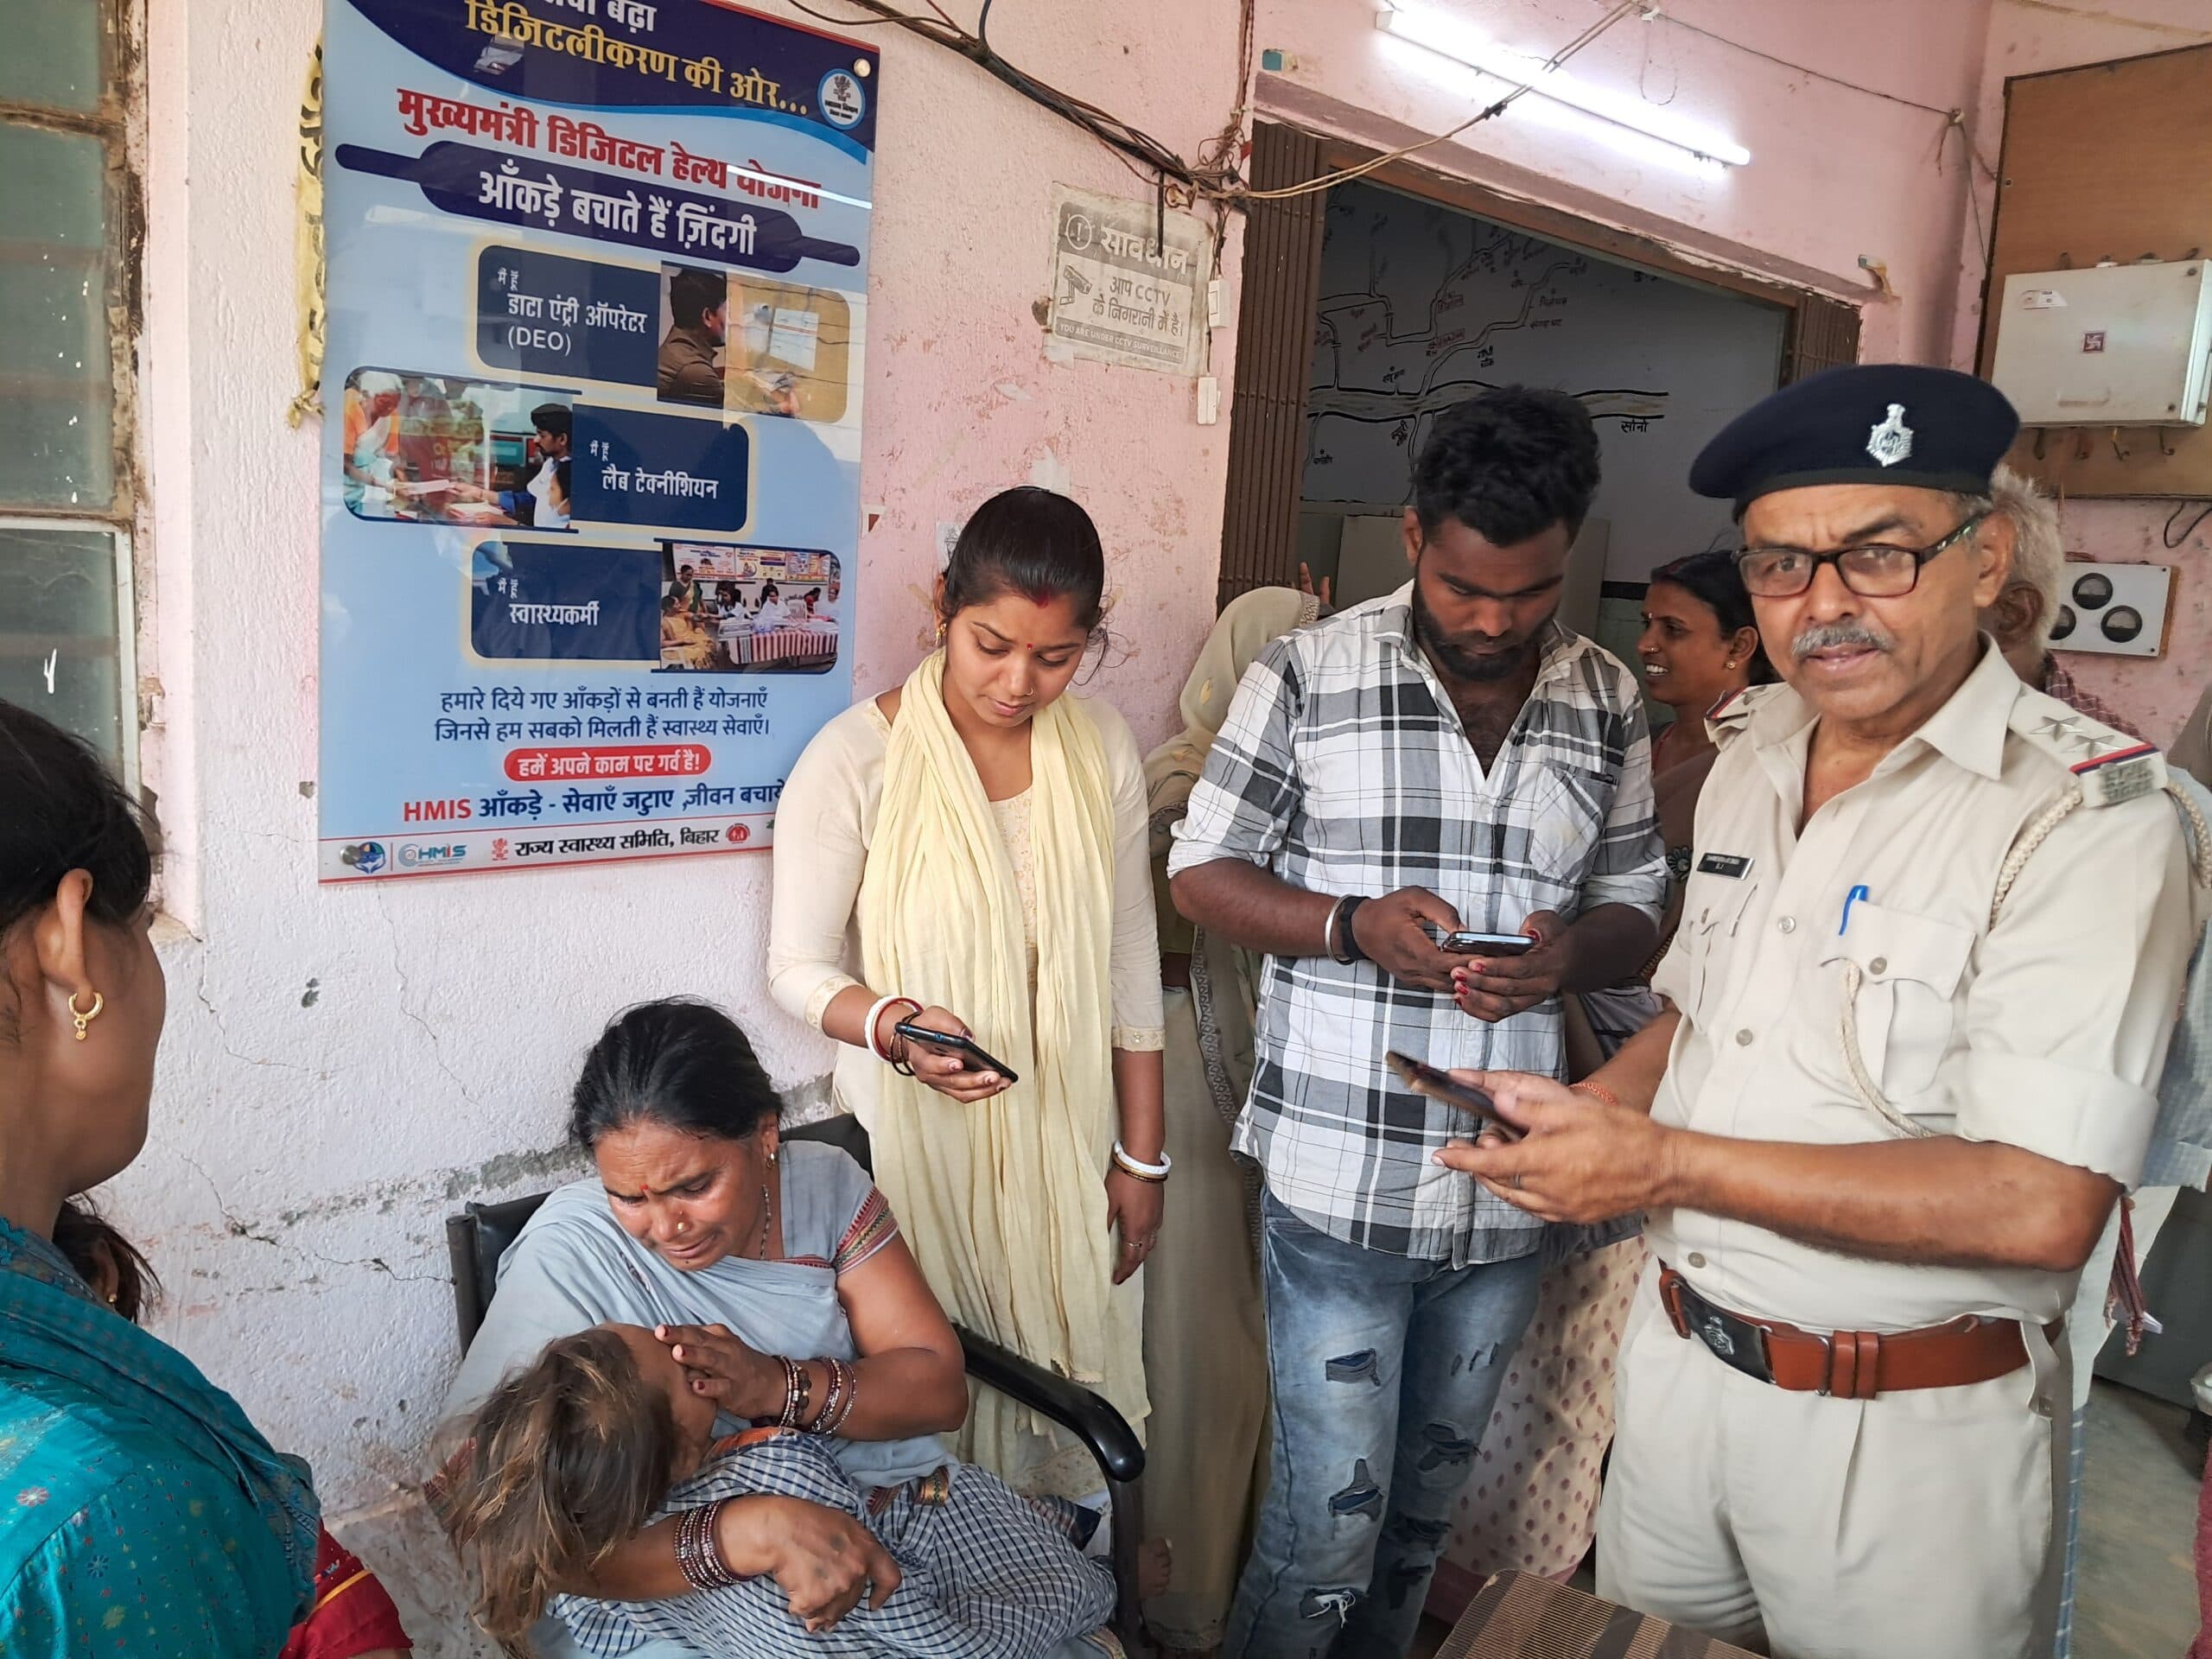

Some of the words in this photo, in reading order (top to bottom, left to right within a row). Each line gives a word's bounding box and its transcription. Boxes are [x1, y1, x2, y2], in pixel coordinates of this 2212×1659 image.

[465, 0, 679, 82] डिजिटलीकरण
[682, 56, 723, 93] की
[397, 88, 539, 149] मुख्यमंत्री
[547, 114, 664, 175] डिजिटल
[671, 141, 728, 189] हेल्थ
[479, 158, 563, 227] आँकड़े
[570, 190, 642, 234] बचाते
[648, 194, 672, 238] हैं
[676, 202, 757, 255] ज़िंदगी
[1101, 226, 1189, 275] सावधान
[1109, 276, 1134, 296] आप
[1135, 284, 1171, 306] CCTV
[507, 293, 543, 318] डाटा
[549, 294, 580, 327] एंट्री
[585, 302, 647, 334] ऑपरेटर
[1108, 297, 1154, 329] निगरानी
[508, 326, 571, 356] (DEO)
[1060, 323, 1074, 334] YOU
[1075, 327, 1090, 337] ARE
[1090, 330, 1114, 343] UNDER
[1115, 338, 1133, 347] CCTV
[601, 463, 630, 491] लैब
[635, 467, 719, 499] टेक्नीशियन
[508, 601, 600, 626] स्वास्थ्यकर्मी
[441, 686, 486, 713] हमारे
[492, 686, 525, 711] दिये
[530, 692, 558, 709] गए
[563, 685, 622, 714] आँकड़ों
[626, 686, 641, 709] से
[646, 686, 689, 709] बनती
[693, 685, 705, 710] हैं
[709, 685, 768, 709] योजनाएँ
[435, 716, 491, 741] जिनसे
[496, 722, 523, 742] हम
[528, 715, 582, 739] सबको
[588, 715, 641, 738] मिलती
[645, 714, 659, 739] हैं
[662, 720, 717, 735] स्वास्थ्य
[518, 753, 549, 777] हमें
[550, 752, 591, 775] अपने
[594, 755, 629, 774] काम
[632, 754, 655, 772] पर
[658, 749, 682, 772] गर्व
[683, 749, 700, 771] है!
[404, 798, 472, 822] HMIS
[479, 789, 543, 820] आँकड़े
[563, 785, 617, 813] सेवाएँ
[515, 841, 554, 856] राज्य
[558, 836, 615, 854] स्वास्थ्य
[680, 827, 720, 845] बिहार
